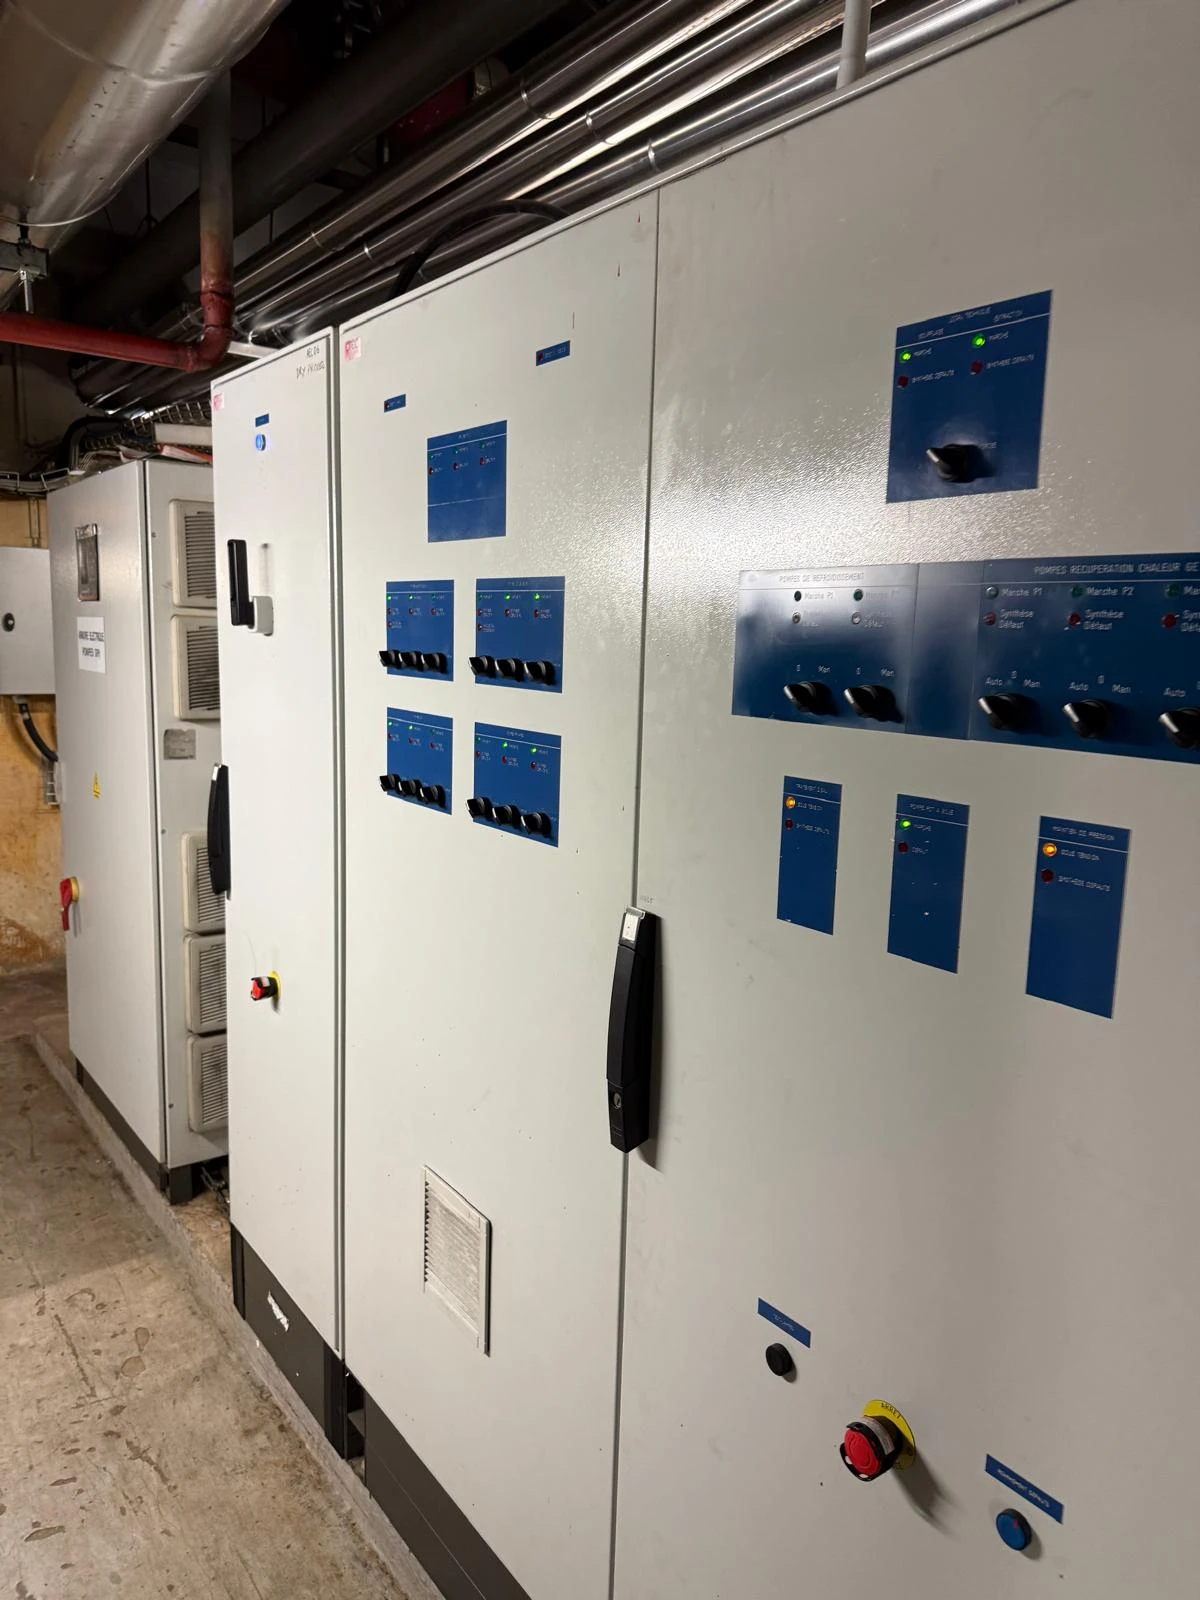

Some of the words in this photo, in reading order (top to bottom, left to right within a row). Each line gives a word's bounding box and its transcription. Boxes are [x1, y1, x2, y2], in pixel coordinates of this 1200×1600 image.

[1034, 563, 1067, 575] POMPES
[1137, 560, 1181, 573] CHALEUR
[1001, 586, 1028, 597] Marche
[1031, 585, 1042, 596] P1
[1086, 585, 1118, 597] Marche
[1121, 585, 1136, 597] P2
[985, 677, 1003, 687] Auto
[1023, 678, 1041, 688] Man
[1069, 681, 1089, 692] Auto
[1112, 684, 1132, 694] Man
[1162, 687, 1186, 698] Auto
